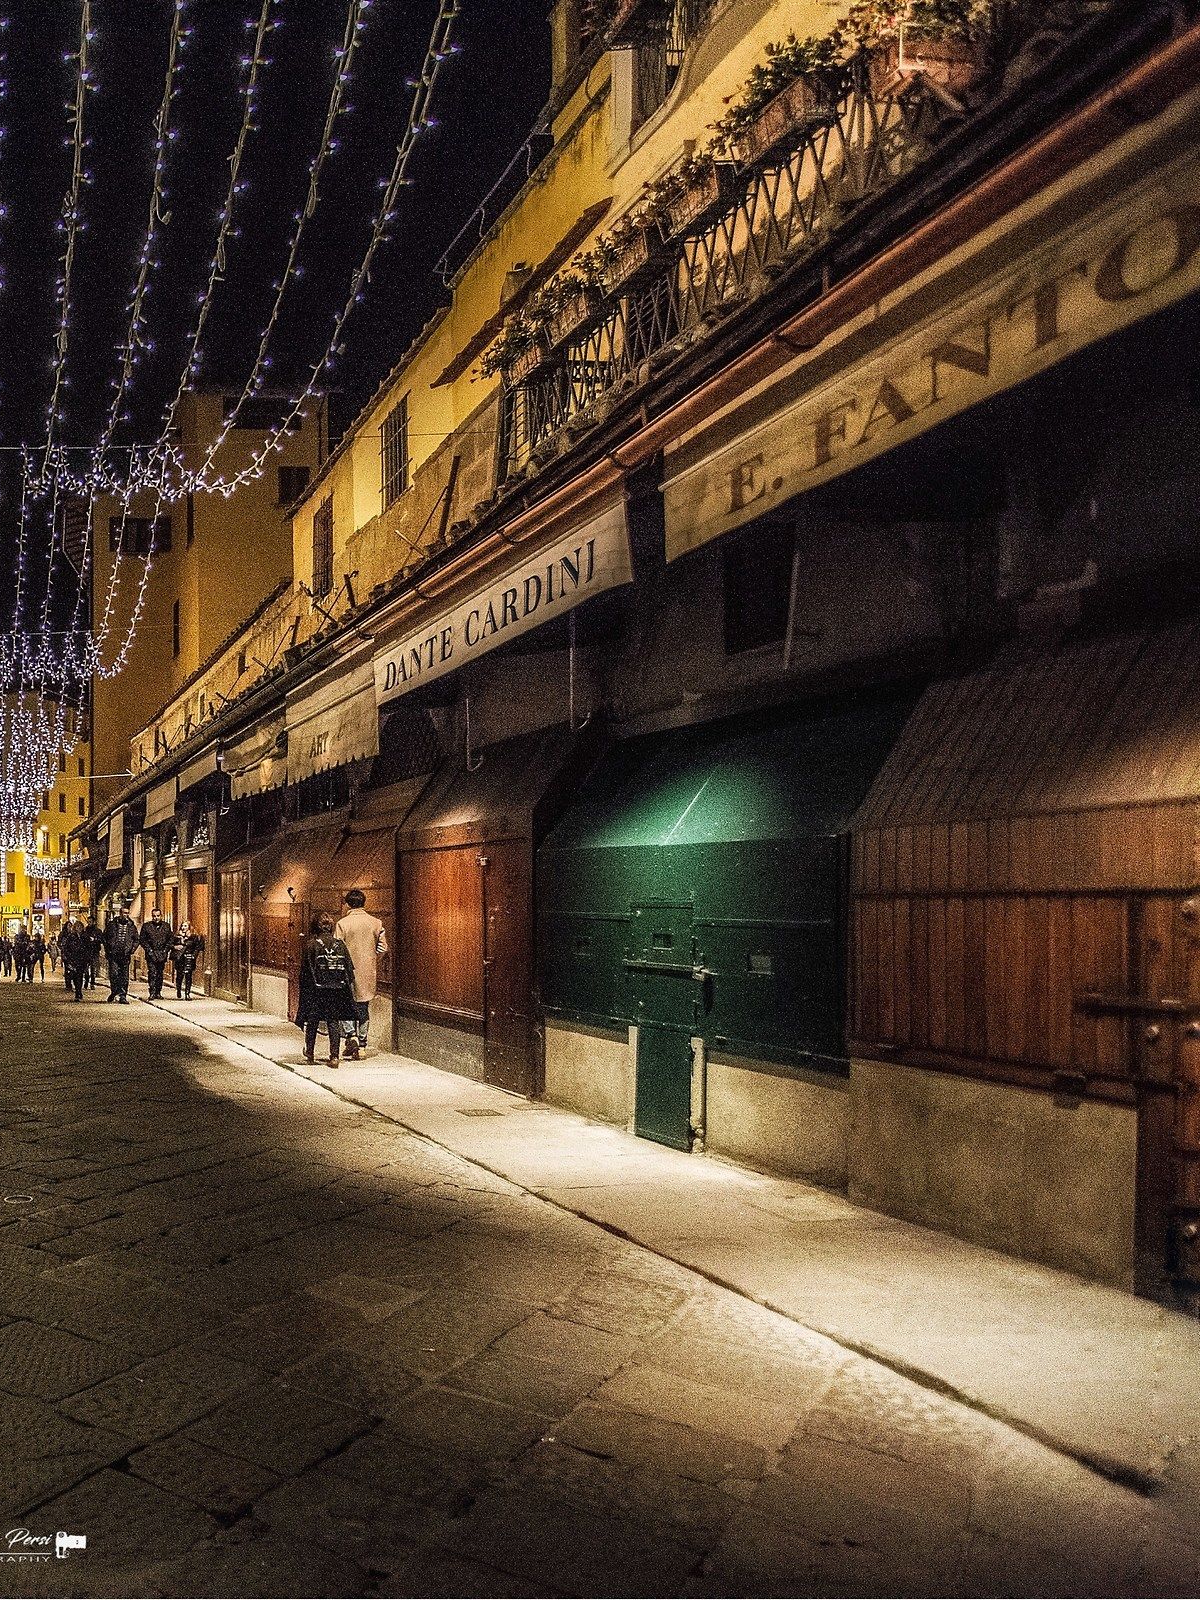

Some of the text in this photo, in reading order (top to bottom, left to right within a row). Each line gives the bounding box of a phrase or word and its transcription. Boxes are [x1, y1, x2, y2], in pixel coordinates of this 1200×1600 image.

[724, 454, 784, 516] E.
[383, 538, 596, 692] DANTE CARDINI
